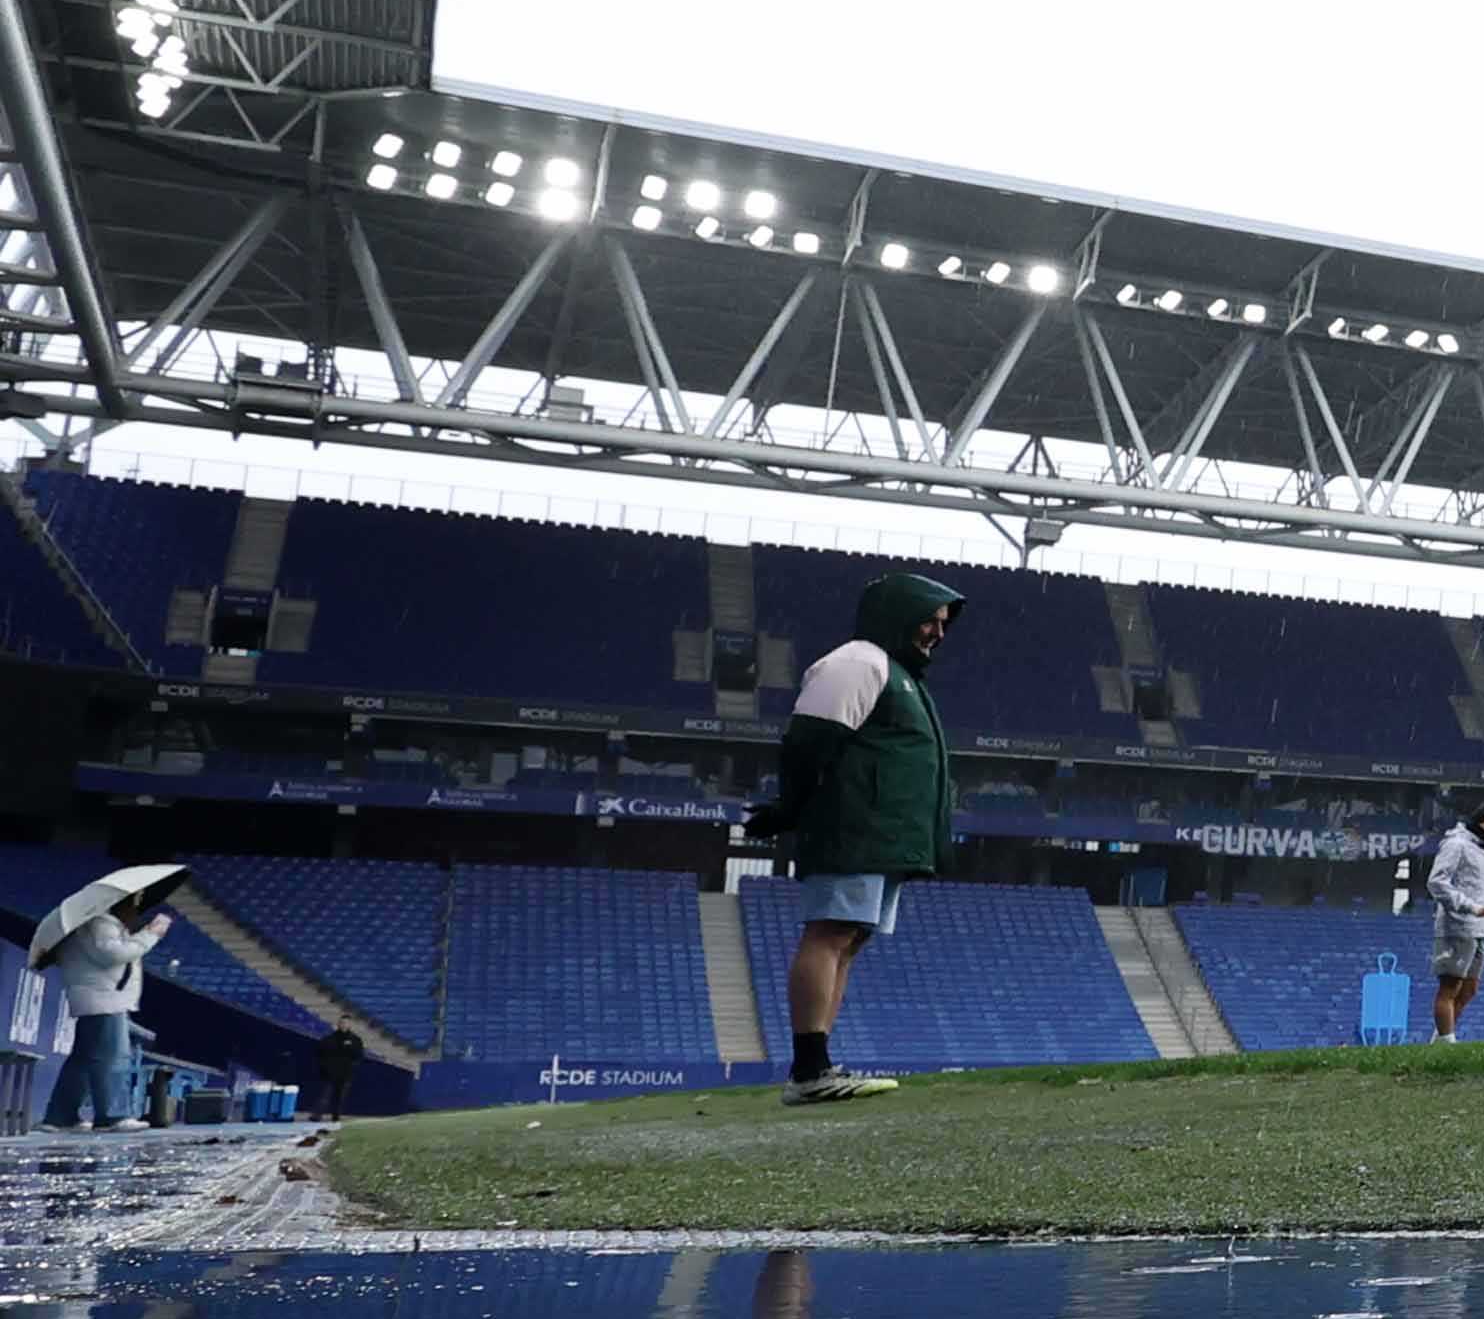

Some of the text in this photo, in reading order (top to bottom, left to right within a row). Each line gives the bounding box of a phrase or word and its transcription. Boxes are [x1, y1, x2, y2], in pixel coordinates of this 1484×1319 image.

[628, 798, 727, 820] CaixaBank
[1201, 824, 1317, 857] CURVA
[539, 1069, 683, 1085] RCDE STADIUM
